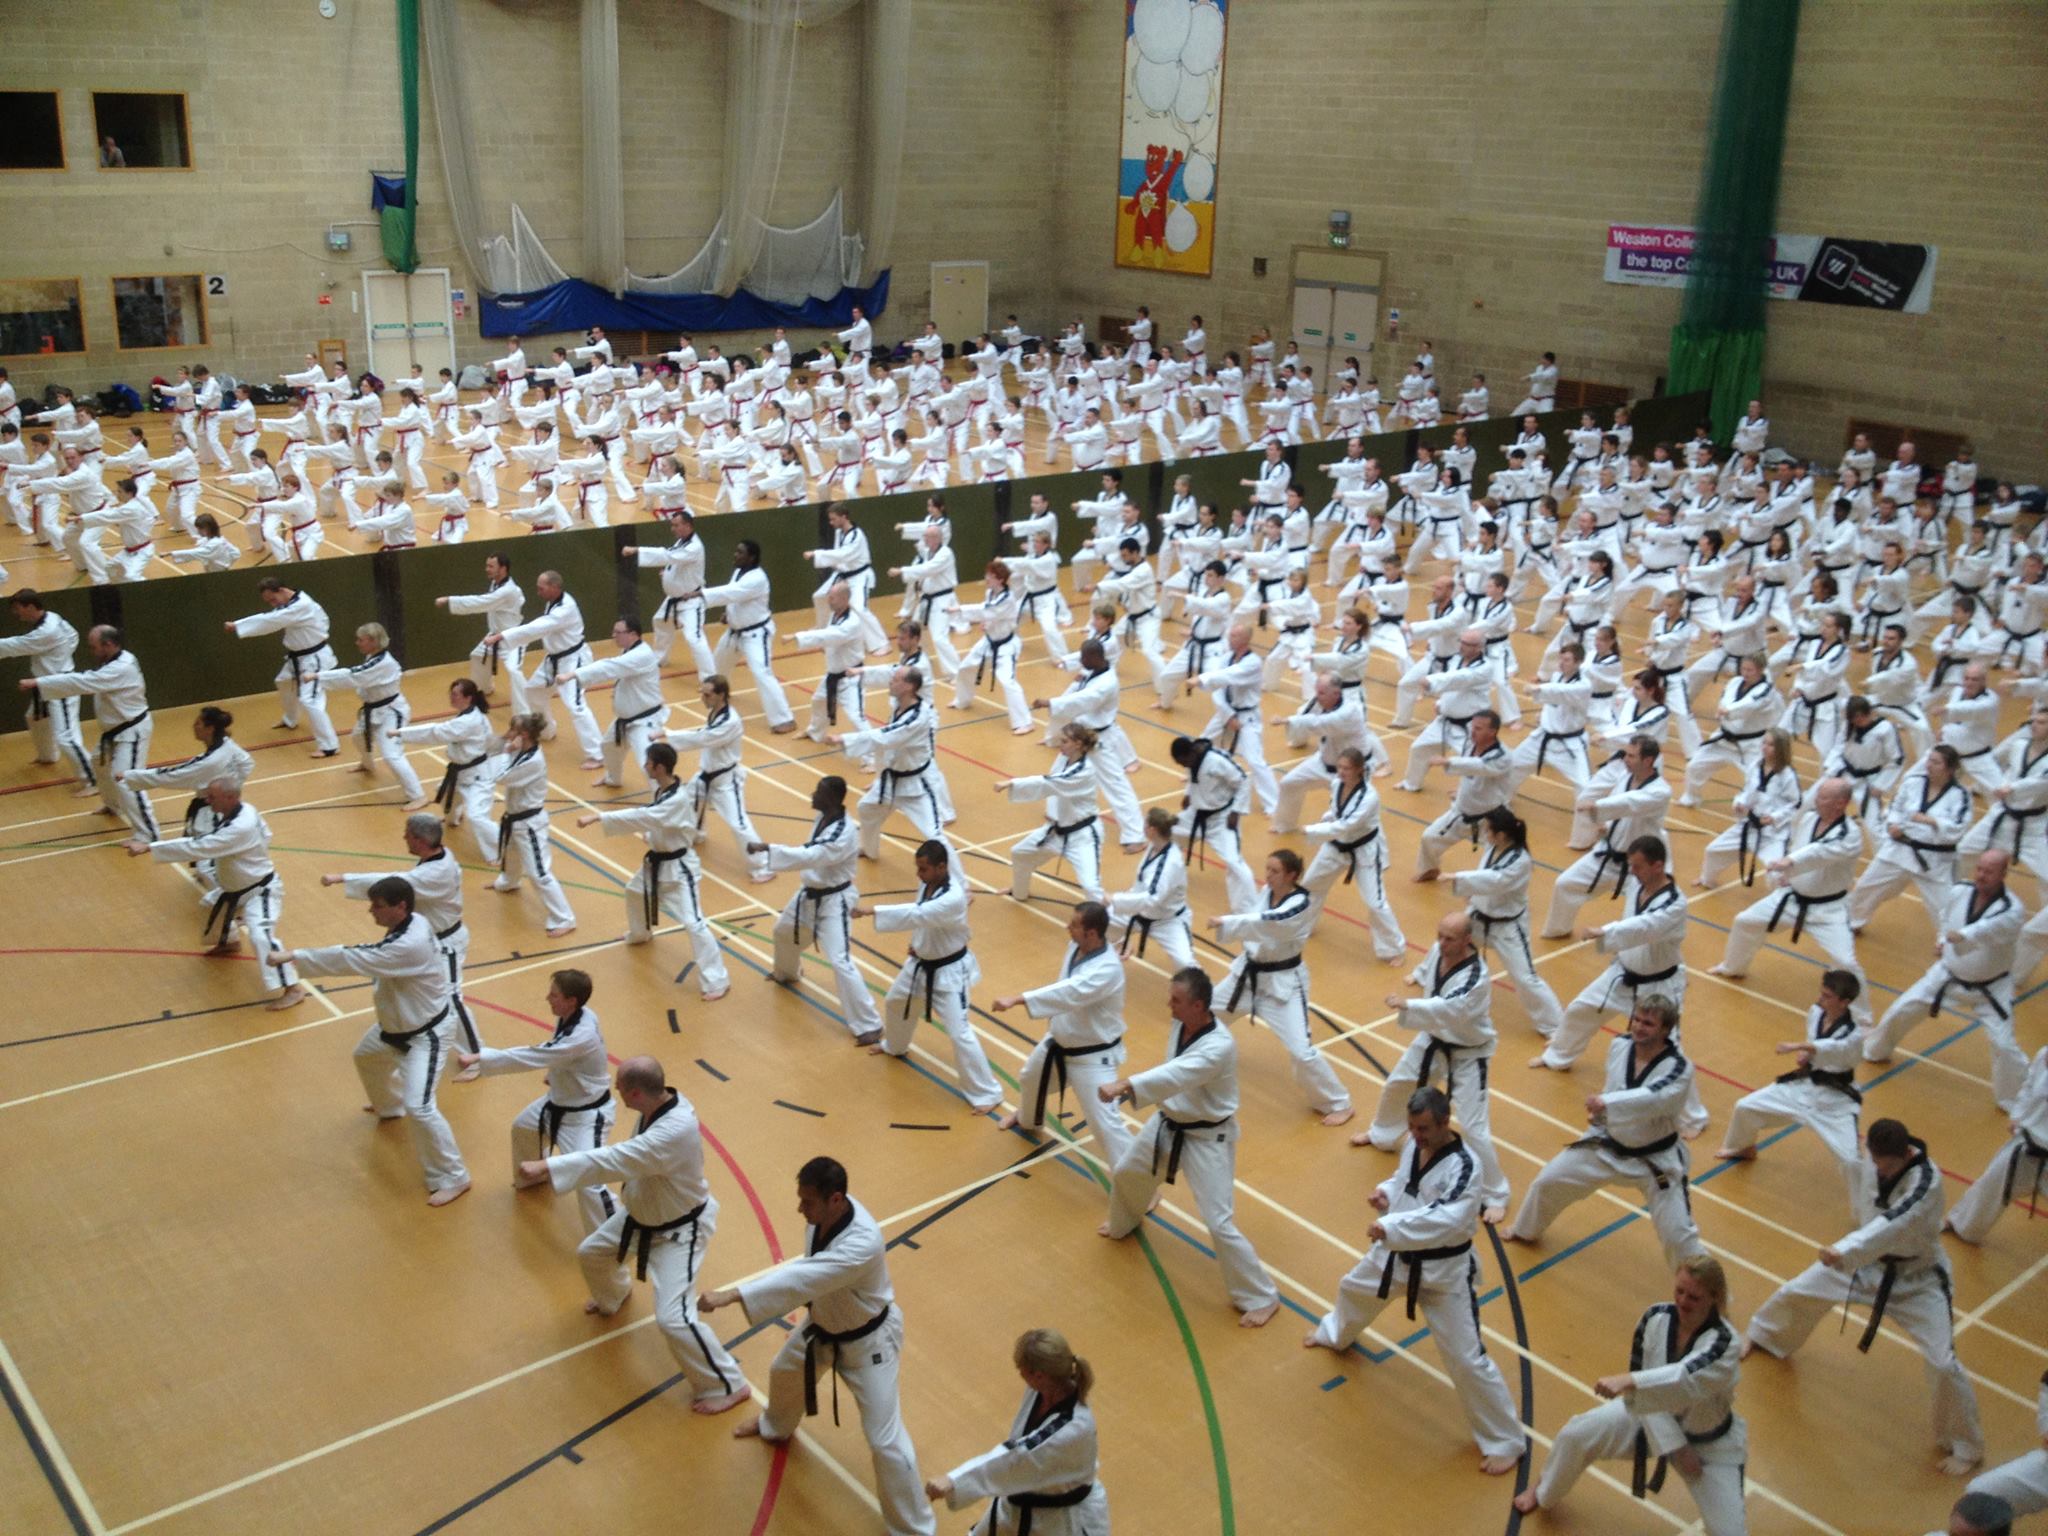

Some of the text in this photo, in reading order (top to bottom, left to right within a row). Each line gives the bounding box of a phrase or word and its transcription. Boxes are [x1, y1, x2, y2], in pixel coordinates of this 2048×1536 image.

[1612, 230, 1661, 248] Weston
[1627, 253, 1648, 268] the
[1650, 255, 1673, 271] top
[1776, 265, 1799, 281] UK
[209, 276, 225, 295] 2
